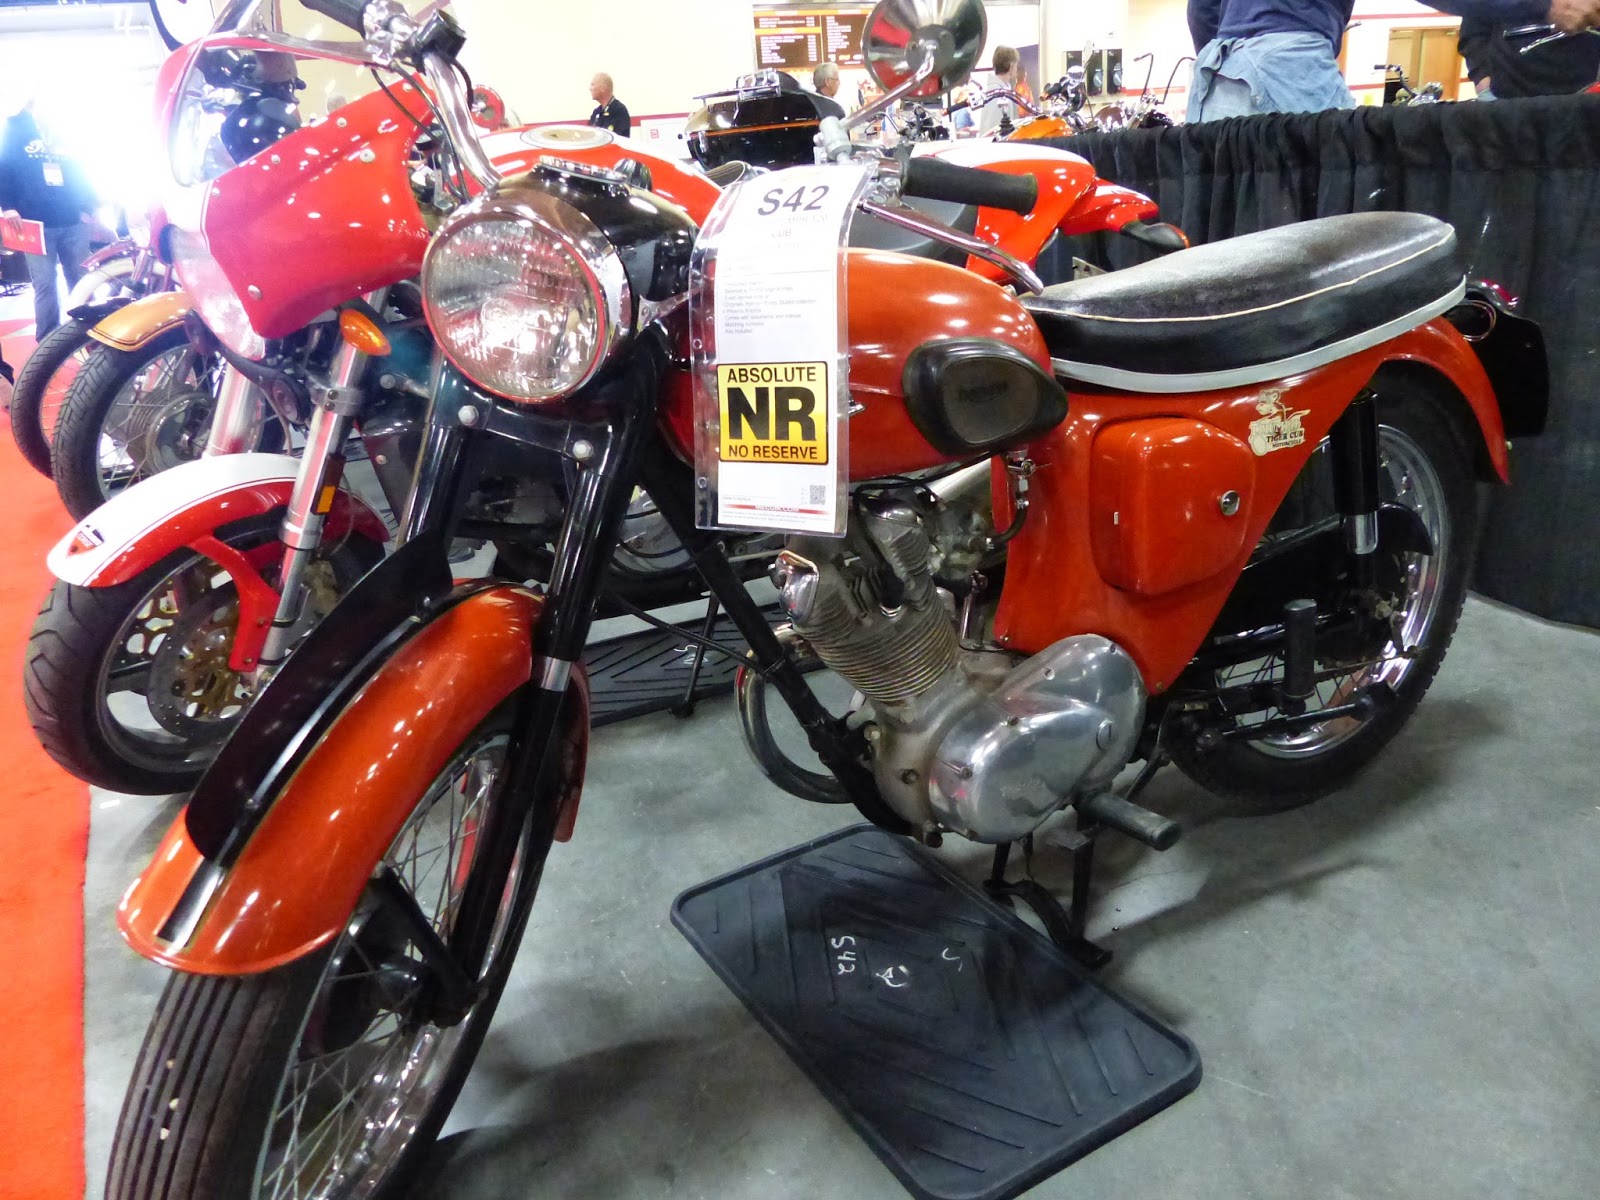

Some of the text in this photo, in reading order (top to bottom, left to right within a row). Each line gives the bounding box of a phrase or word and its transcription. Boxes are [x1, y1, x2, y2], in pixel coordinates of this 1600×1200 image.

[757, 185, 830, 216] S42
[727, 366, 817, 383] ABSOLUTE
[727, 386, 817, 442] NR
[1266, 430, 1304, 443] TIGER CUB
[728, 445, 818, 460] NO RESERVE
[830, 935, 857, 976] S42
